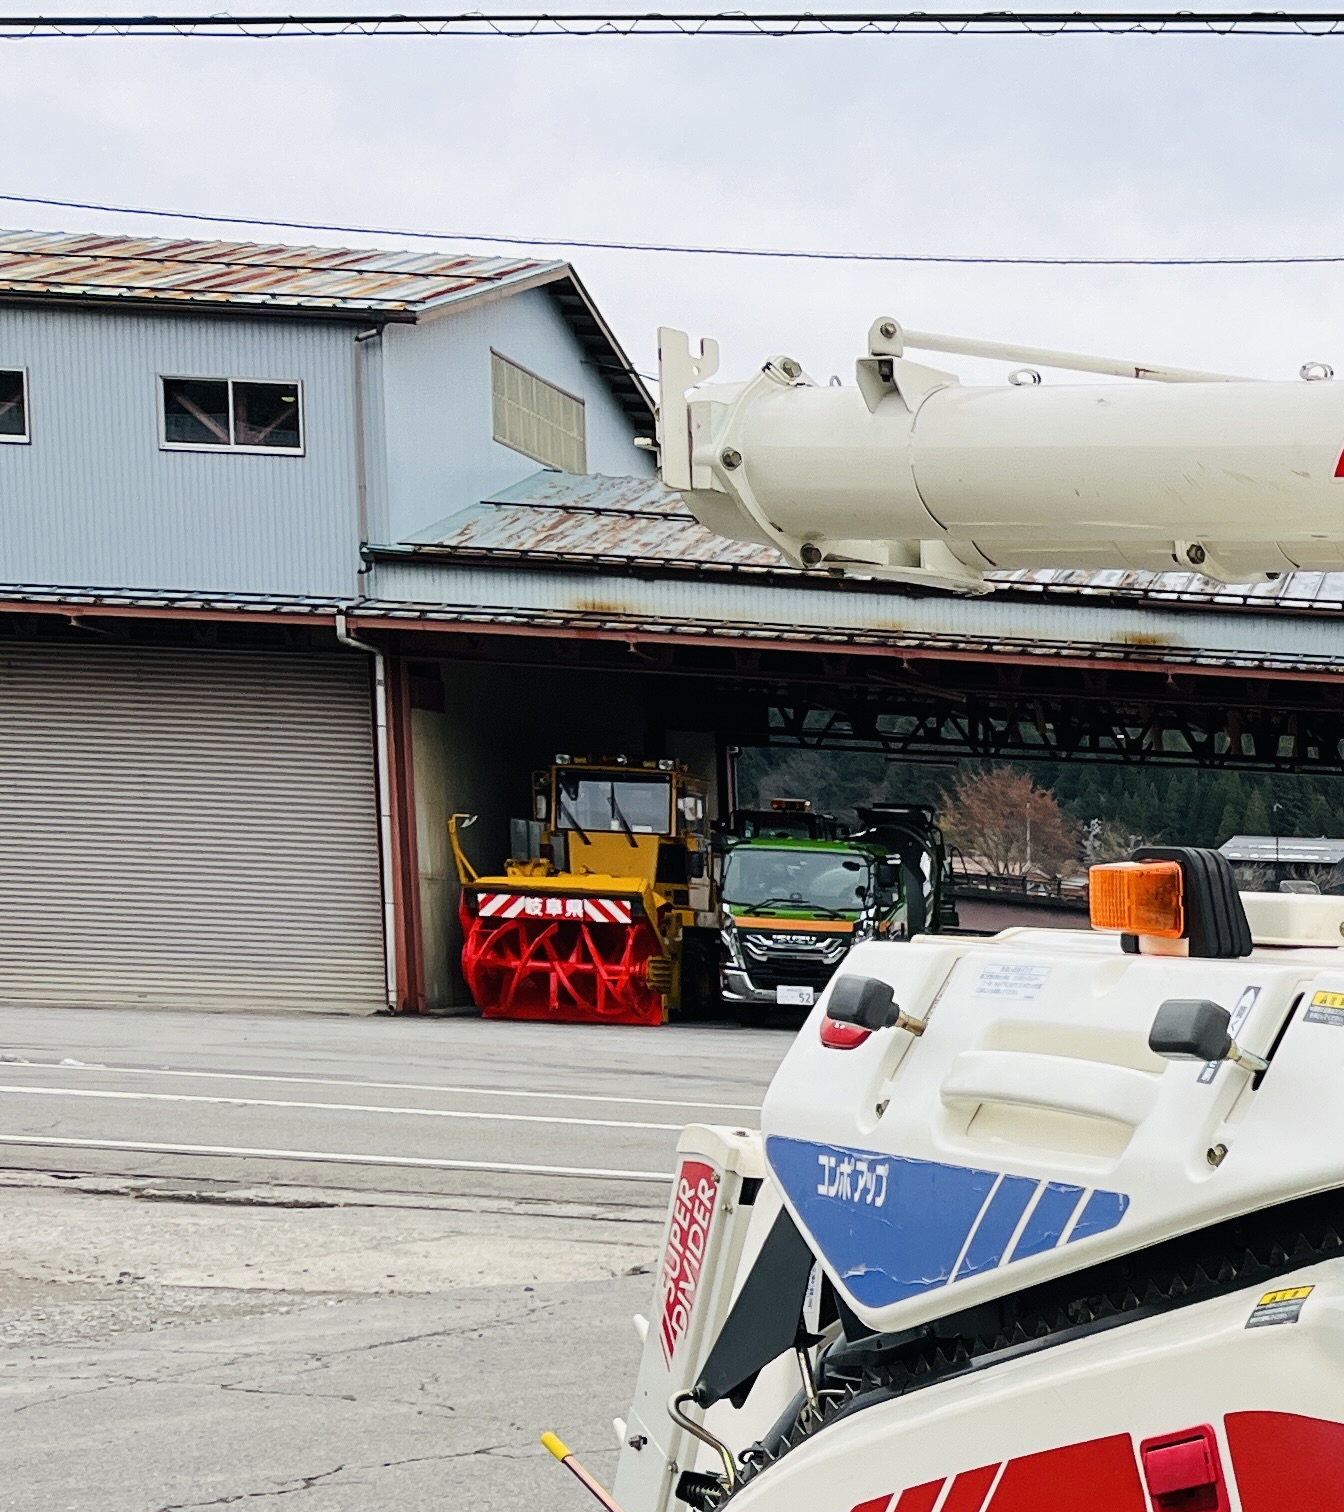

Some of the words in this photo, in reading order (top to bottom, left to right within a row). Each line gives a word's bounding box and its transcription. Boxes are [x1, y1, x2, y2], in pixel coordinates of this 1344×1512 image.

[525, 896, 584, 918] 岐阜県
[771, 933, 818, 945] ISUZU
[816, 1154, 890, 1208] コンポアップ
[661, 1177, 696, 1304] SUPER
[670, 1177, 716, 1338] DIVIDER
